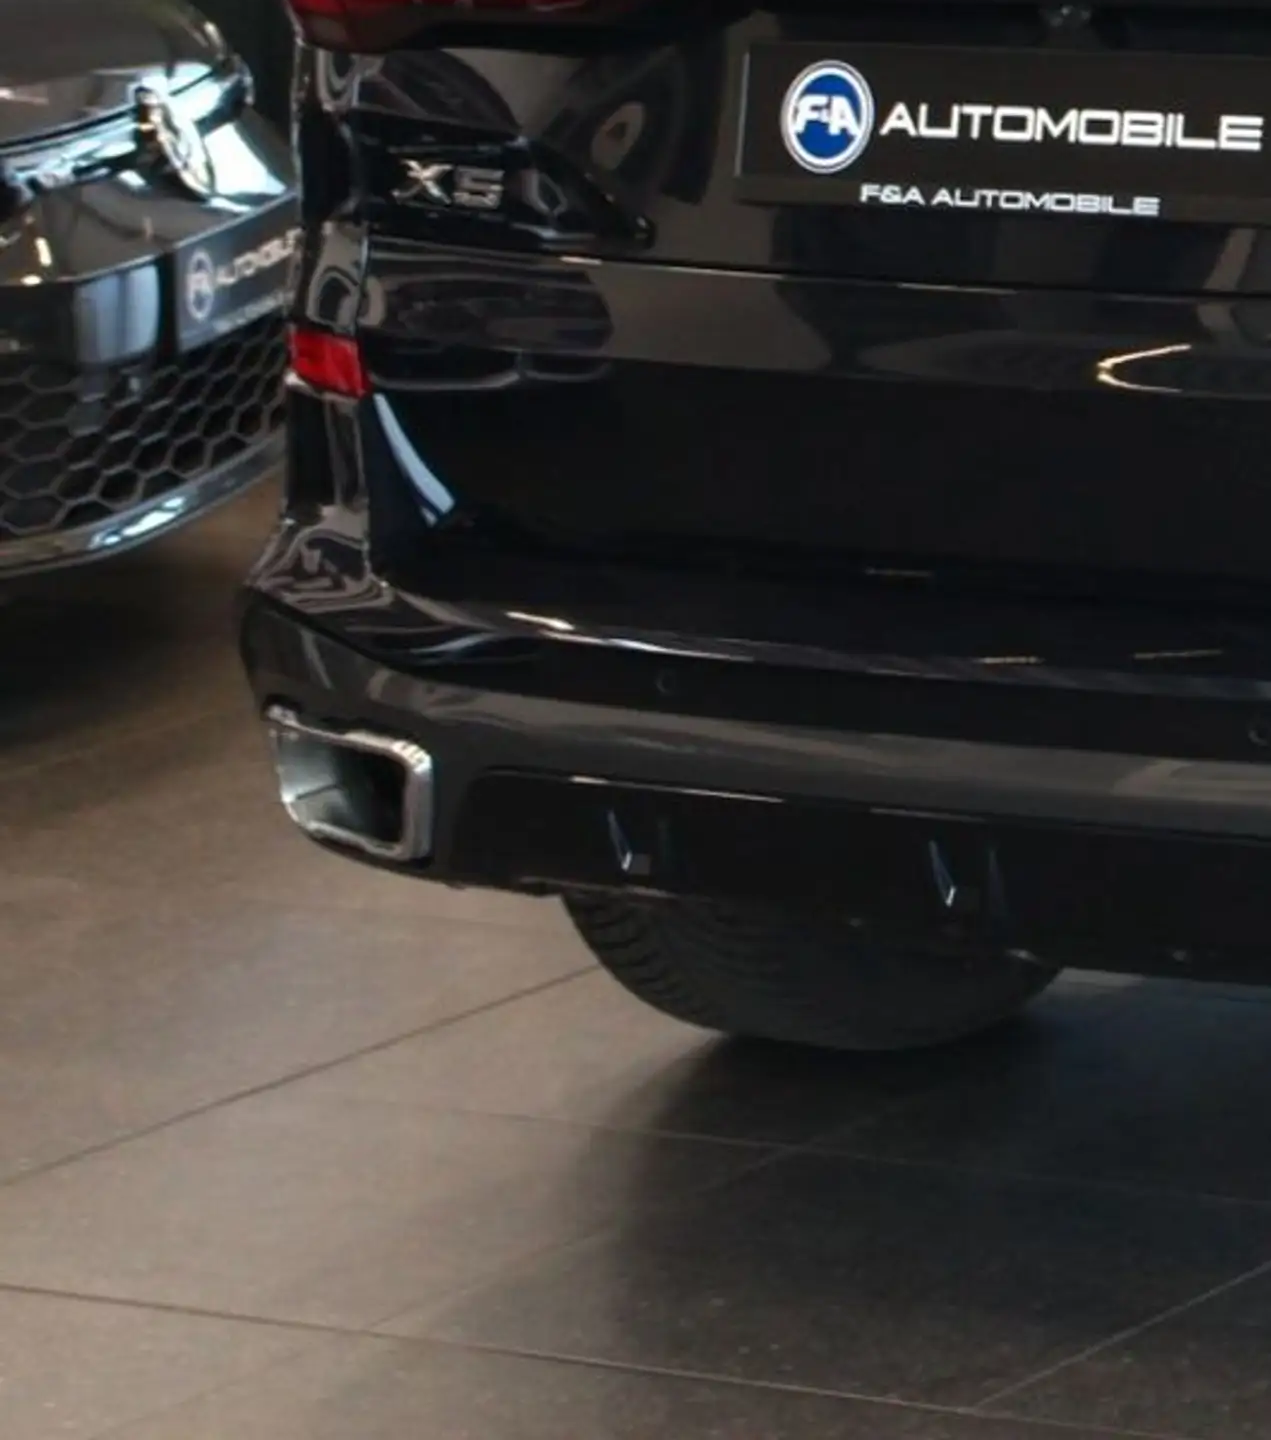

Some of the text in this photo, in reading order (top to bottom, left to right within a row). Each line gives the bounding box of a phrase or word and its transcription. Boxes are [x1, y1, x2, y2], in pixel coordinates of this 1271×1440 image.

[879, 101, 1264, 151] AUTOMOBILE
[392, 159, 505, 209] X5
[859, 183, 1160, 216] F&A AUTOMOBILE
